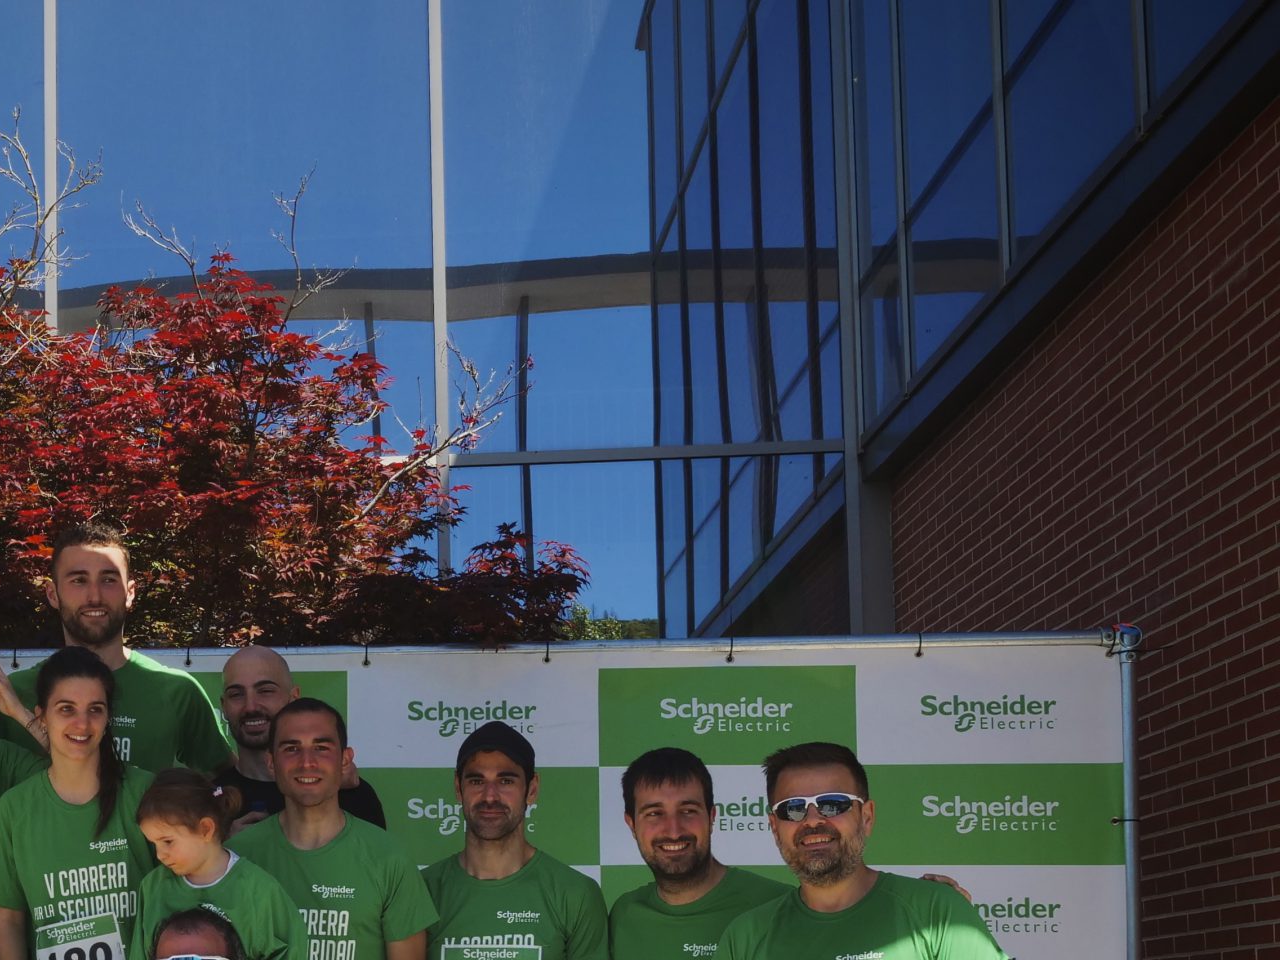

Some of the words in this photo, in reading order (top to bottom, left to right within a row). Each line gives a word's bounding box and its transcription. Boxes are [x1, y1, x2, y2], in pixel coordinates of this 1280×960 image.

[408, 700, 537, 721] Schneider
[660, 697, 793, 720] Schneider
[920, 695, 1057, 717] Schneider
[719, 718, 790, 732] Electric
[980, 716, 1055, 730] Electric
[922, 794, 1059, 817] Schneider
[720, 819, 772, 831] Elect
[980, 818, 1057, 832] Electric
[89, 838, 128, 850] Schneider
[44, 873, 55, 898] V
[58, 862, 128, 897] CARRERA
[312, 884, 355, 895] Schneider
[44, 904, 55, 918] LA
[974, 897, 1061, 918] neider
[497, 910, 540, 920] Schneider
[47, 922, 96, 939] Schneider
[985, 920, 1059, 933] Electric
[66, 930, 96, 941] Electric
[463, 949, 519, 959] Schneider
[683, 943, 718, 952] Schneid
